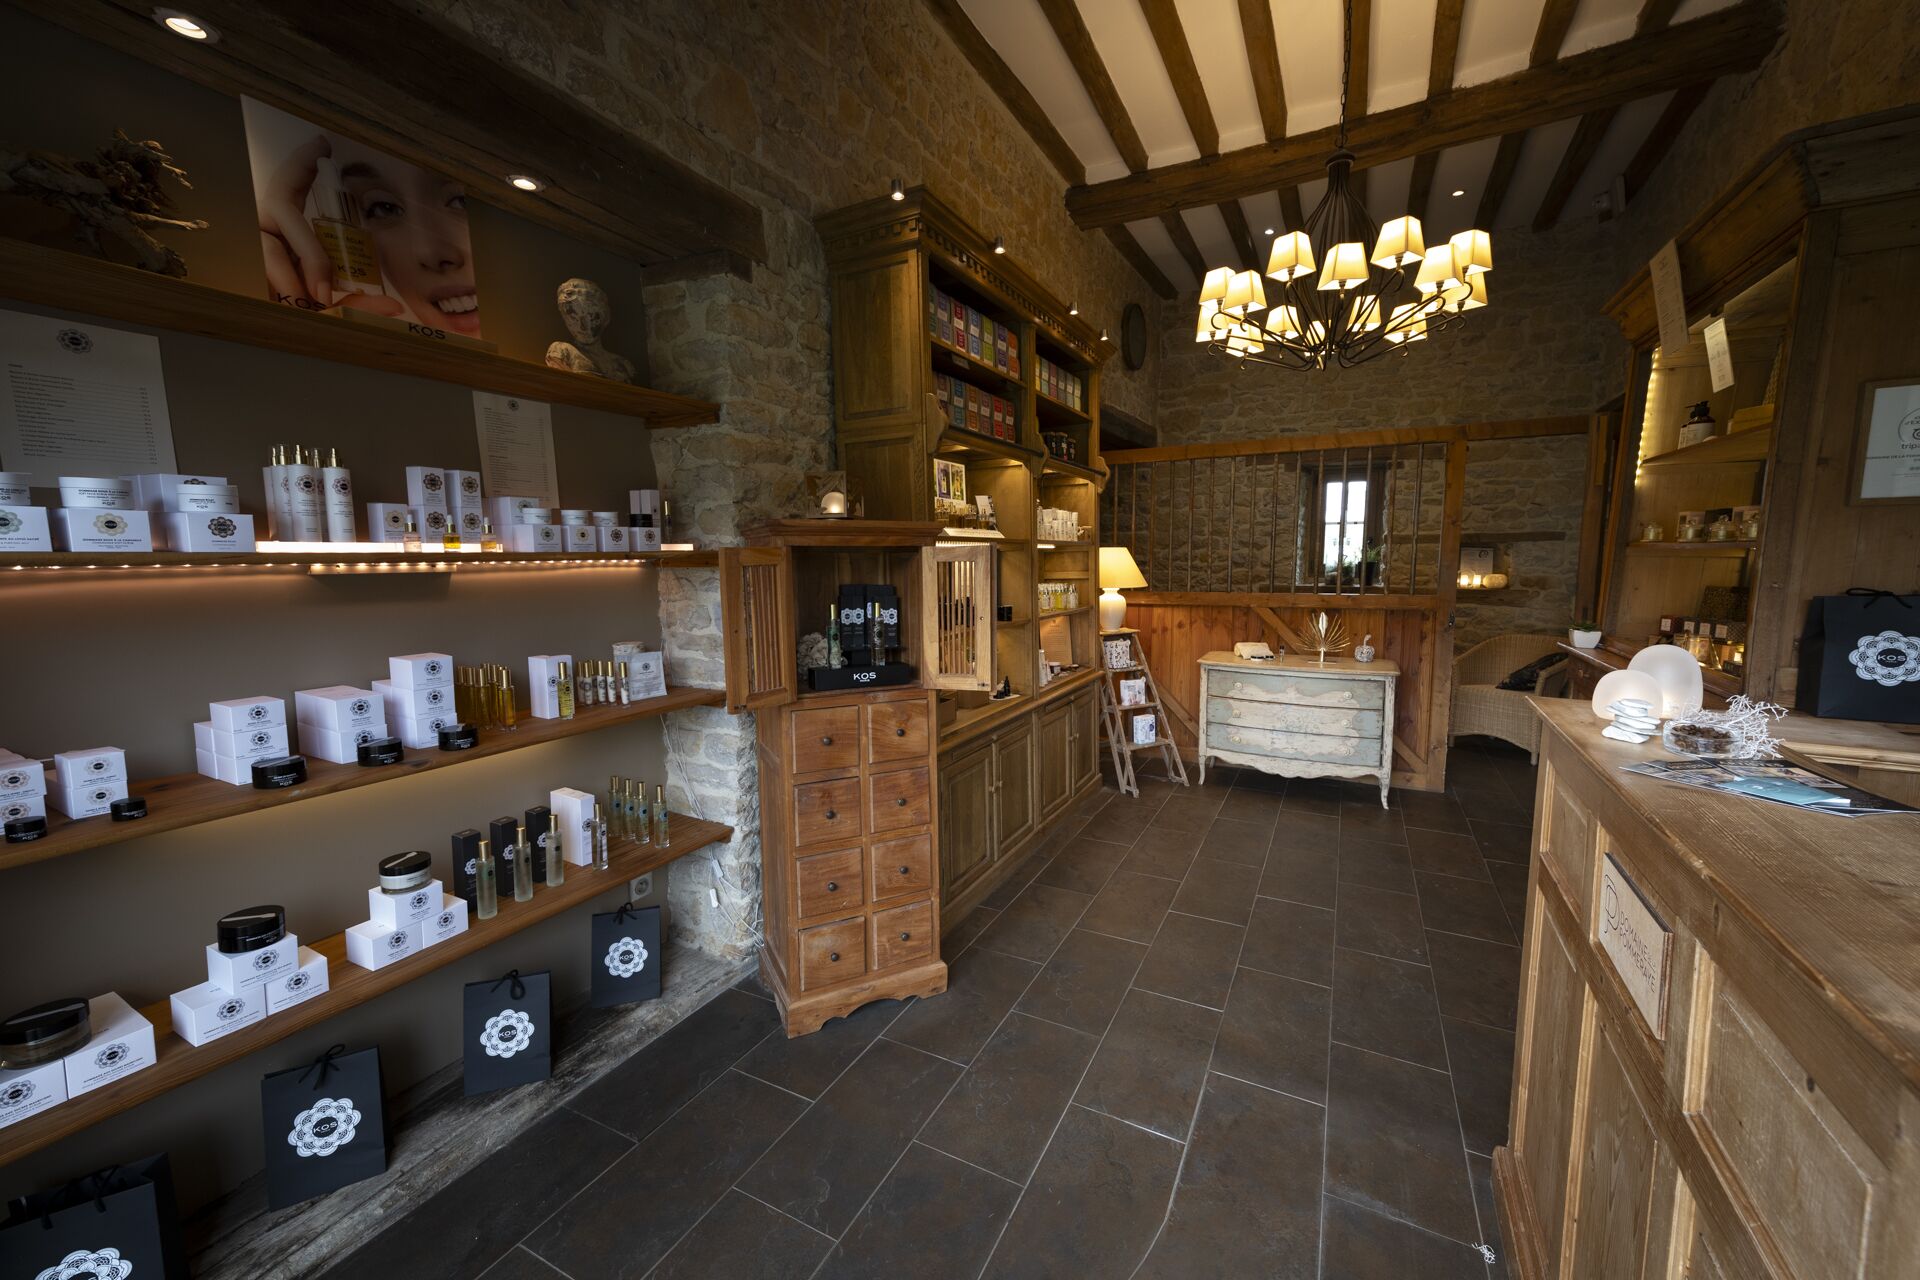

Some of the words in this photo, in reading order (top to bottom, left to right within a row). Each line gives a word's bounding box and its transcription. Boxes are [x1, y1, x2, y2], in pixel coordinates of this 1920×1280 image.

[408, 322, 446, 340] KOS
[1877, 654, 1906, 662] KOS
[853, 671, 877, 681] KOS
[1620, 911, 1648, 961] DOMAINE
[498, 1029, 517, 1038] KOS
[313, 1121, 338, 1134] KOS
